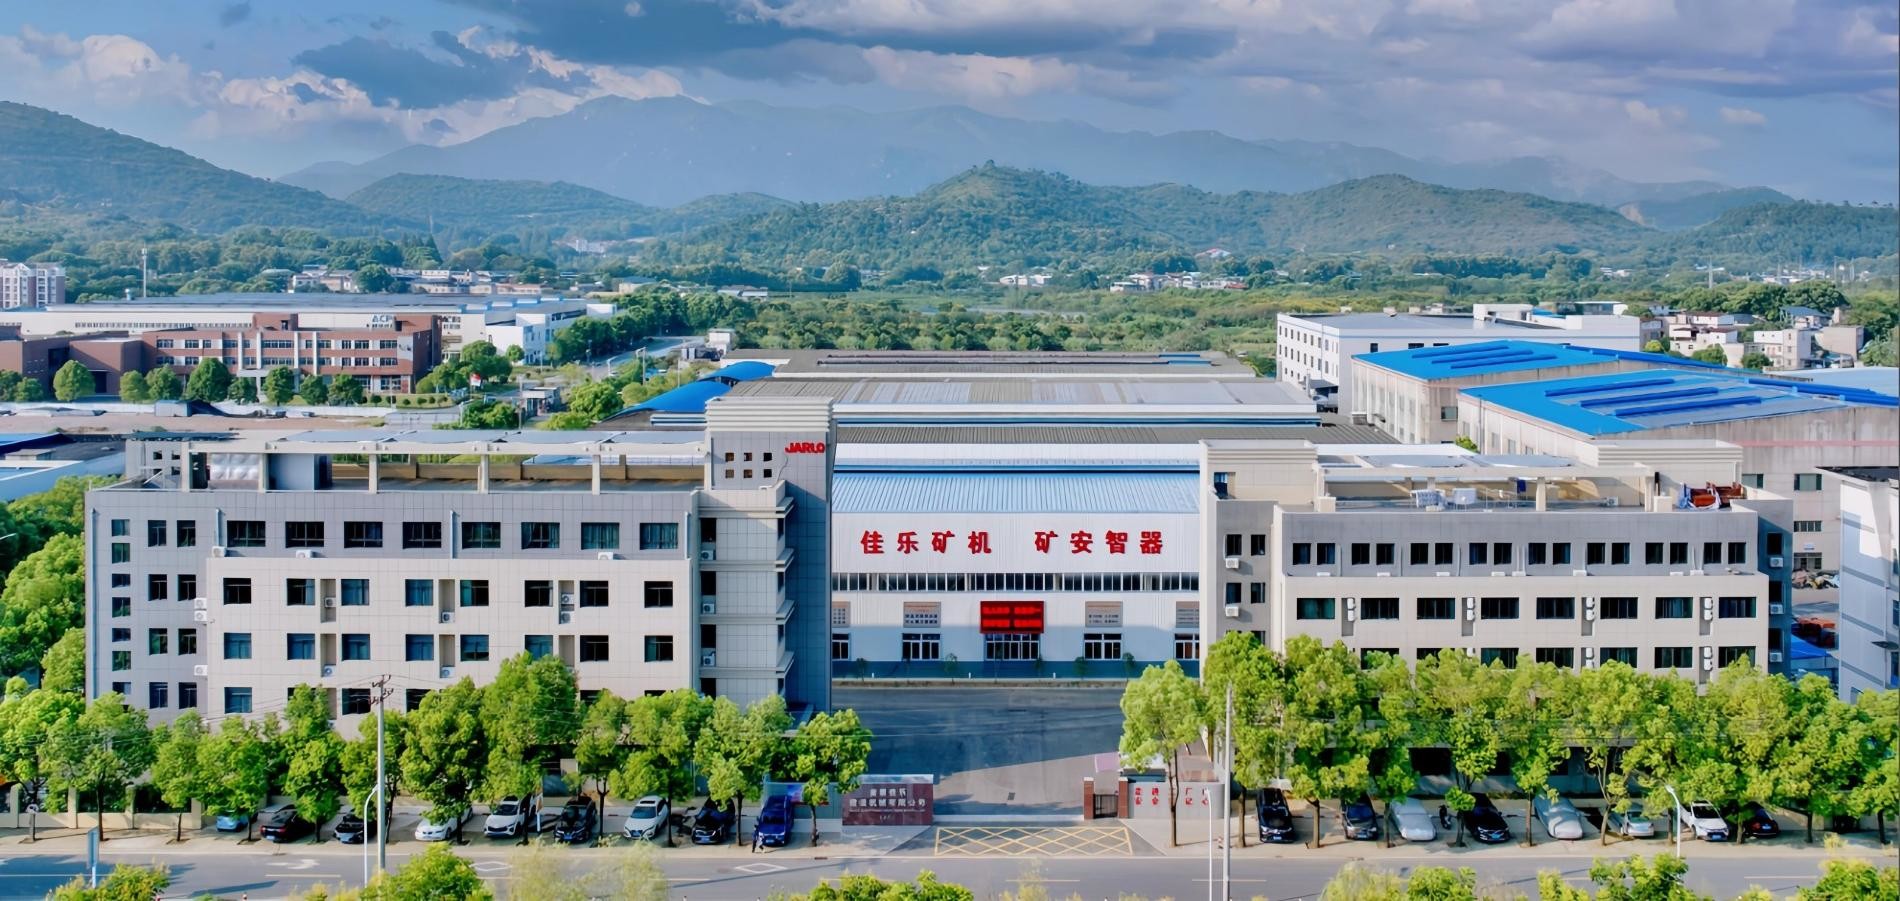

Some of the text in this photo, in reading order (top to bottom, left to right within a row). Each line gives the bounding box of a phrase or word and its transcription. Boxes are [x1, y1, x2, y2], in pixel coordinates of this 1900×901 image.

[785, 442, 825, 454] JARLO
[861, 530, 1163, 554] 佳乐矿机 矿安智器
